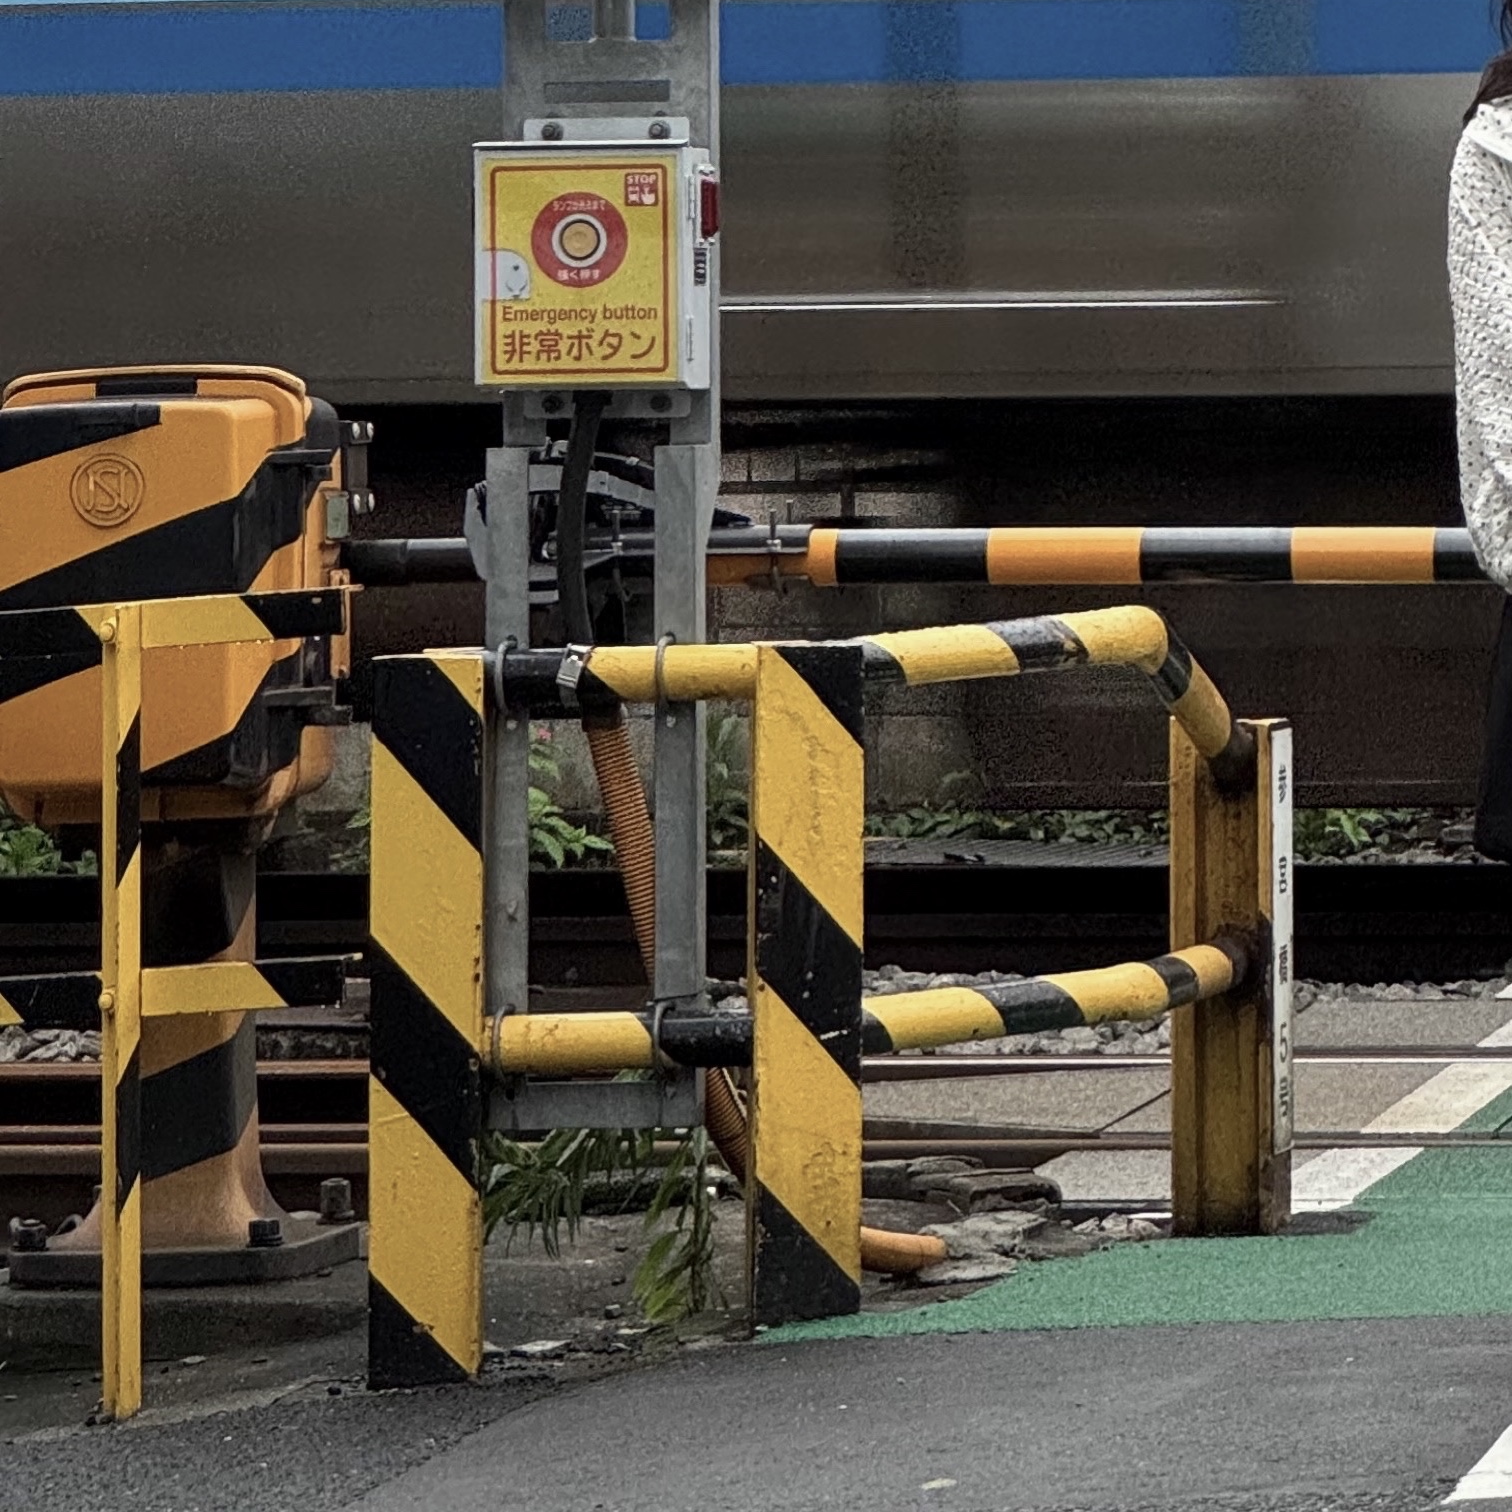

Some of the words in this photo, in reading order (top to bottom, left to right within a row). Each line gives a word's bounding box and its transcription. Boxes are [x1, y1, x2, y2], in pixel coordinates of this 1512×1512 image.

[626, 174, 657, 185] STOP
[502, 305, 597, 325] Emergency
[603, 303, 658, 321] button
[503, 328, 656, 364] 非常ボタン
